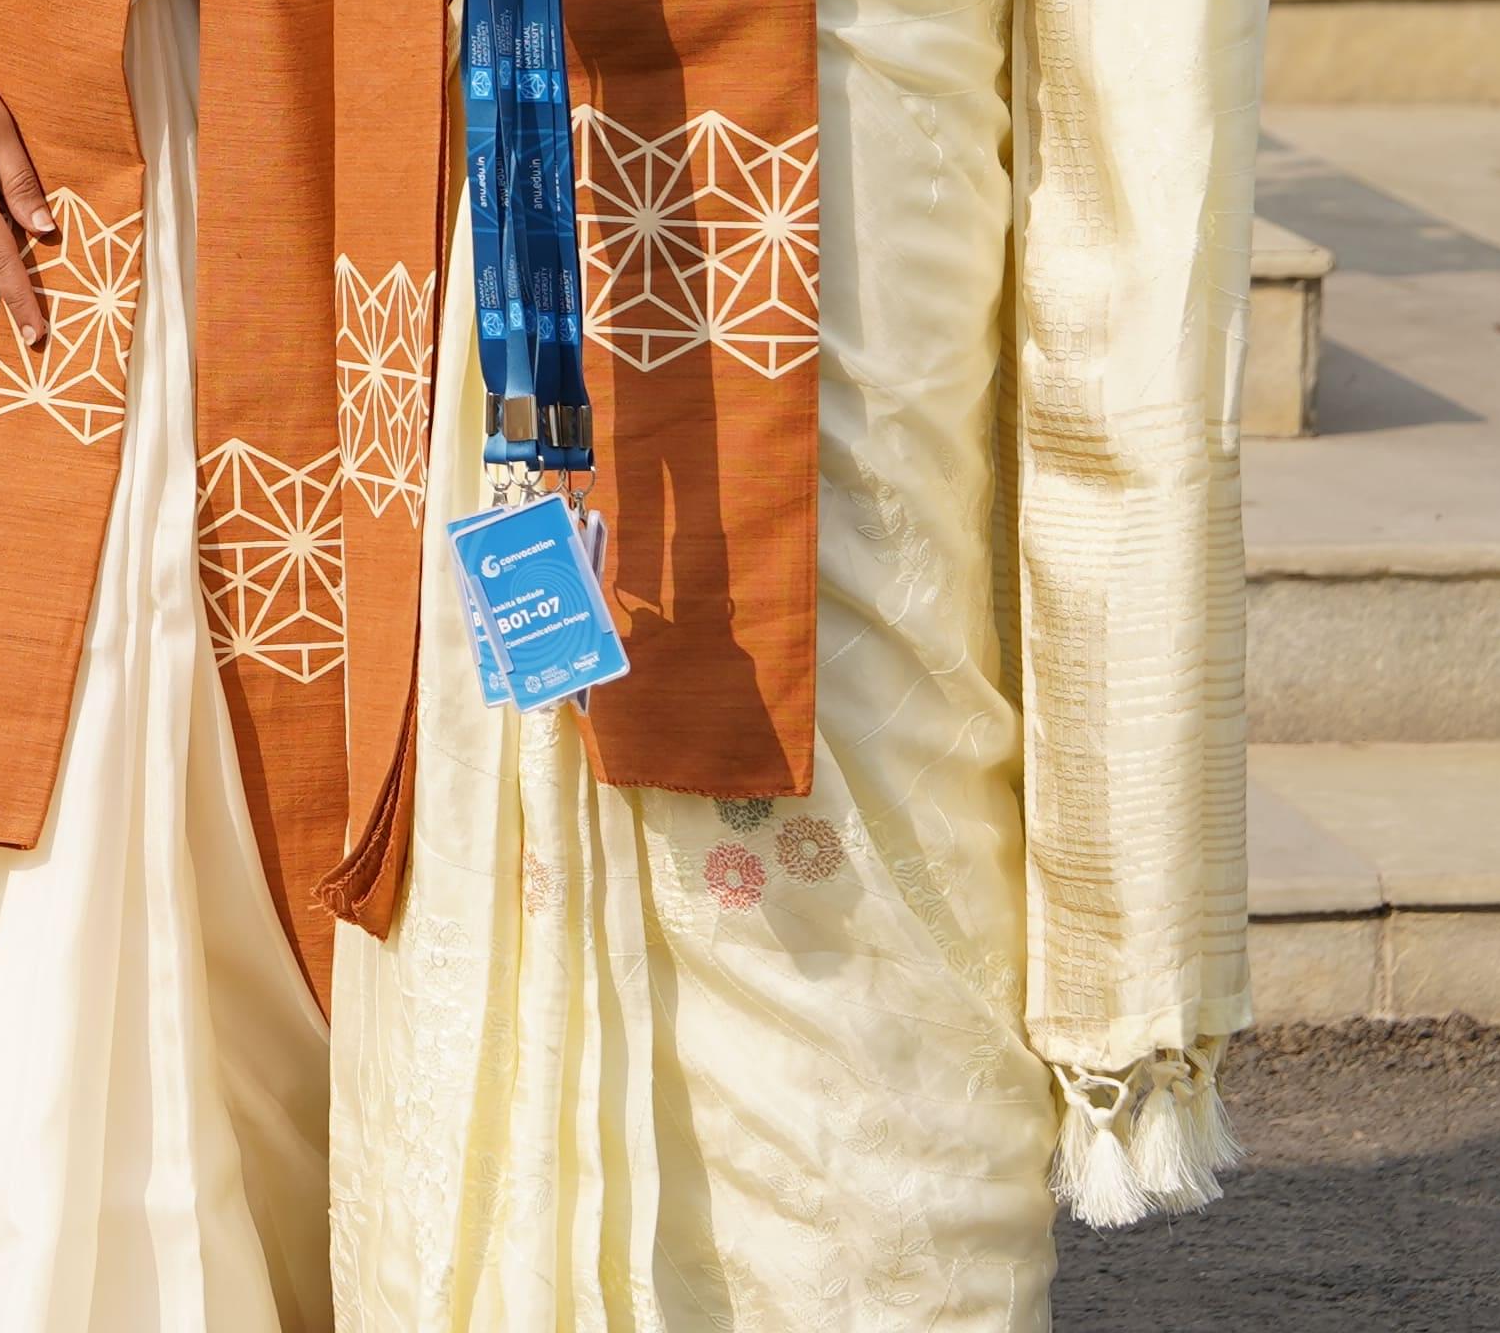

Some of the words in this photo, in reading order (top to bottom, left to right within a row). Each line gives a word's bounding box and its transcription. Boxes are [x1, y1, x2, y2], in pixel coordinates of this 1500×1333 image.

[523, 25, 532, 69] NATIONAL
[531, 20, 541, 69] UNIVERSITY
[476, 156, 488, 208] anu.edu.in
[529, 158, 544, 210] anu.edu.in
[499, 538, 556, 566] convocation
[497, 596, 561, 634] B01-07
[504, 621, 565, 649] Communication
[564, 611, 590, 627] Design
